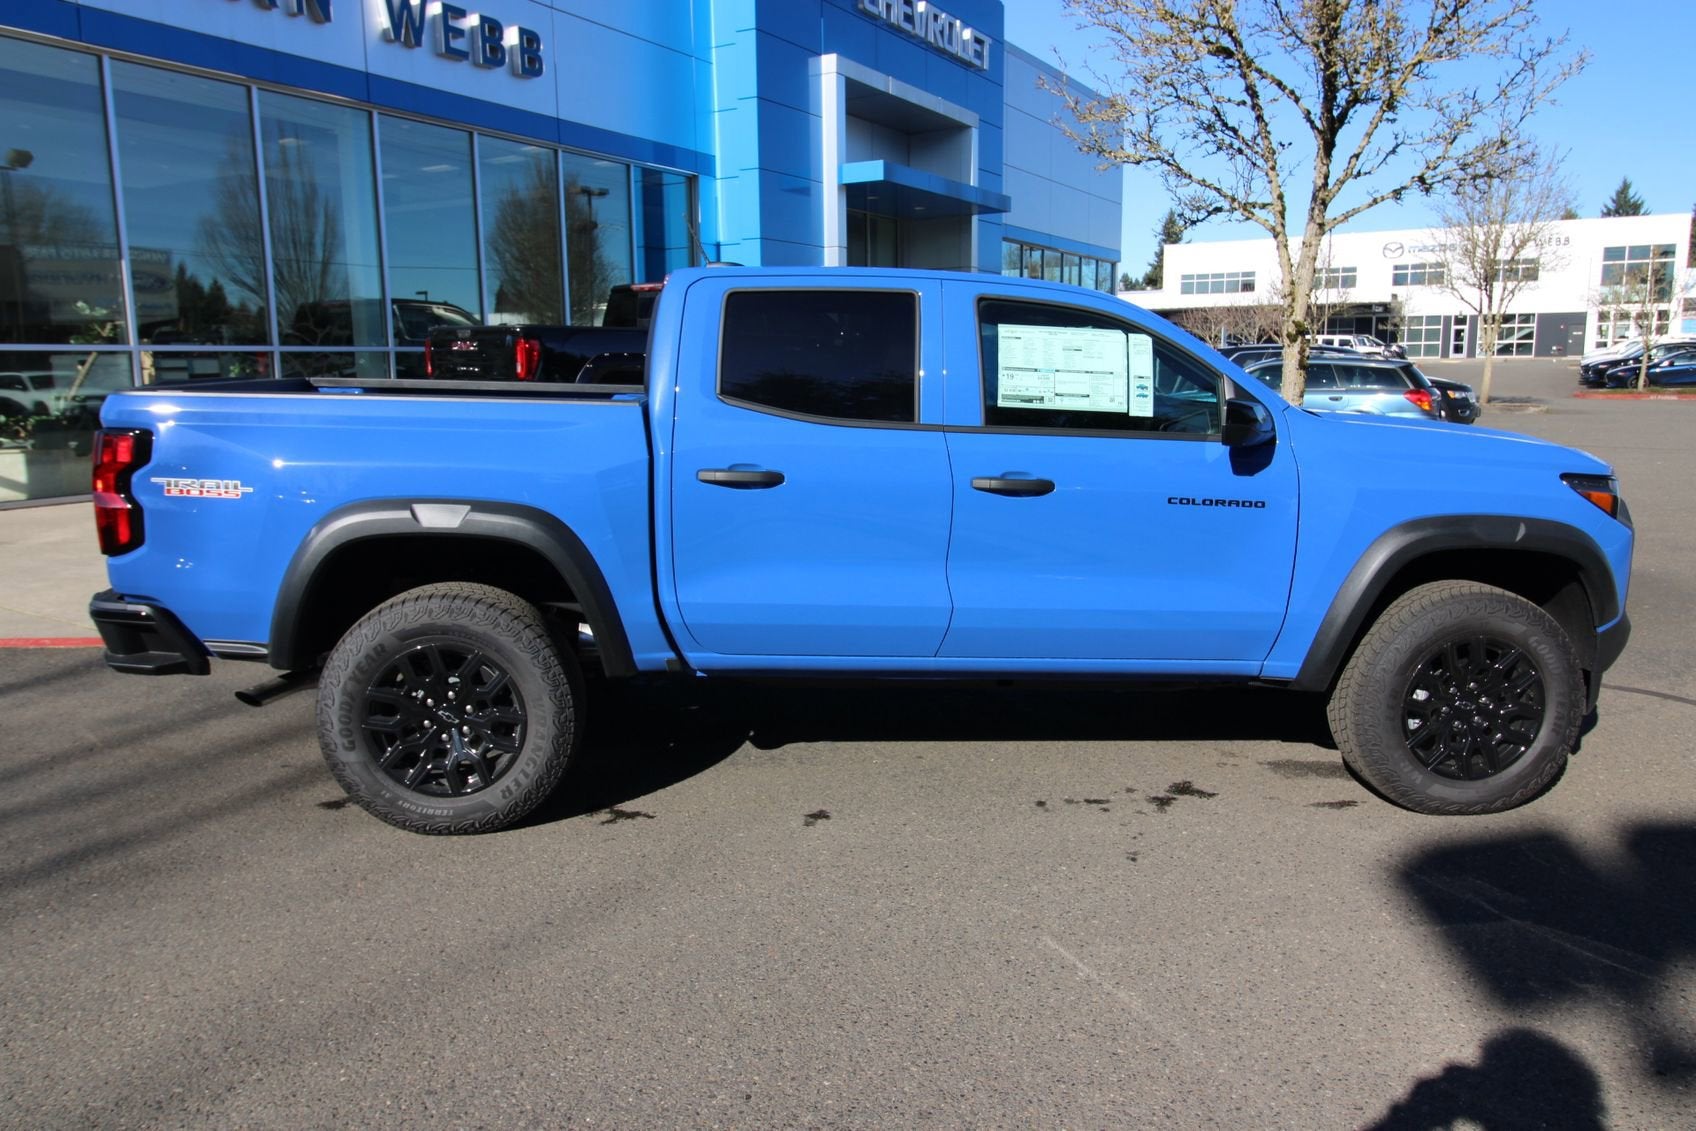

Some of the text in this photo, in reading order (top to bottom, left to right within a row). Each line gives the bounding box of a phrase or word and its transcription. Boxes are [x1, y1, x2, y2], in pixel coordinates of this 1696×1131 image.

[376, 0, 543, 79] WEBB
[150, 478, 253, 491] TRAIL
[164, 488, 241, 498] BOSS
[1167, 496, 1266, 509] COLORADO
